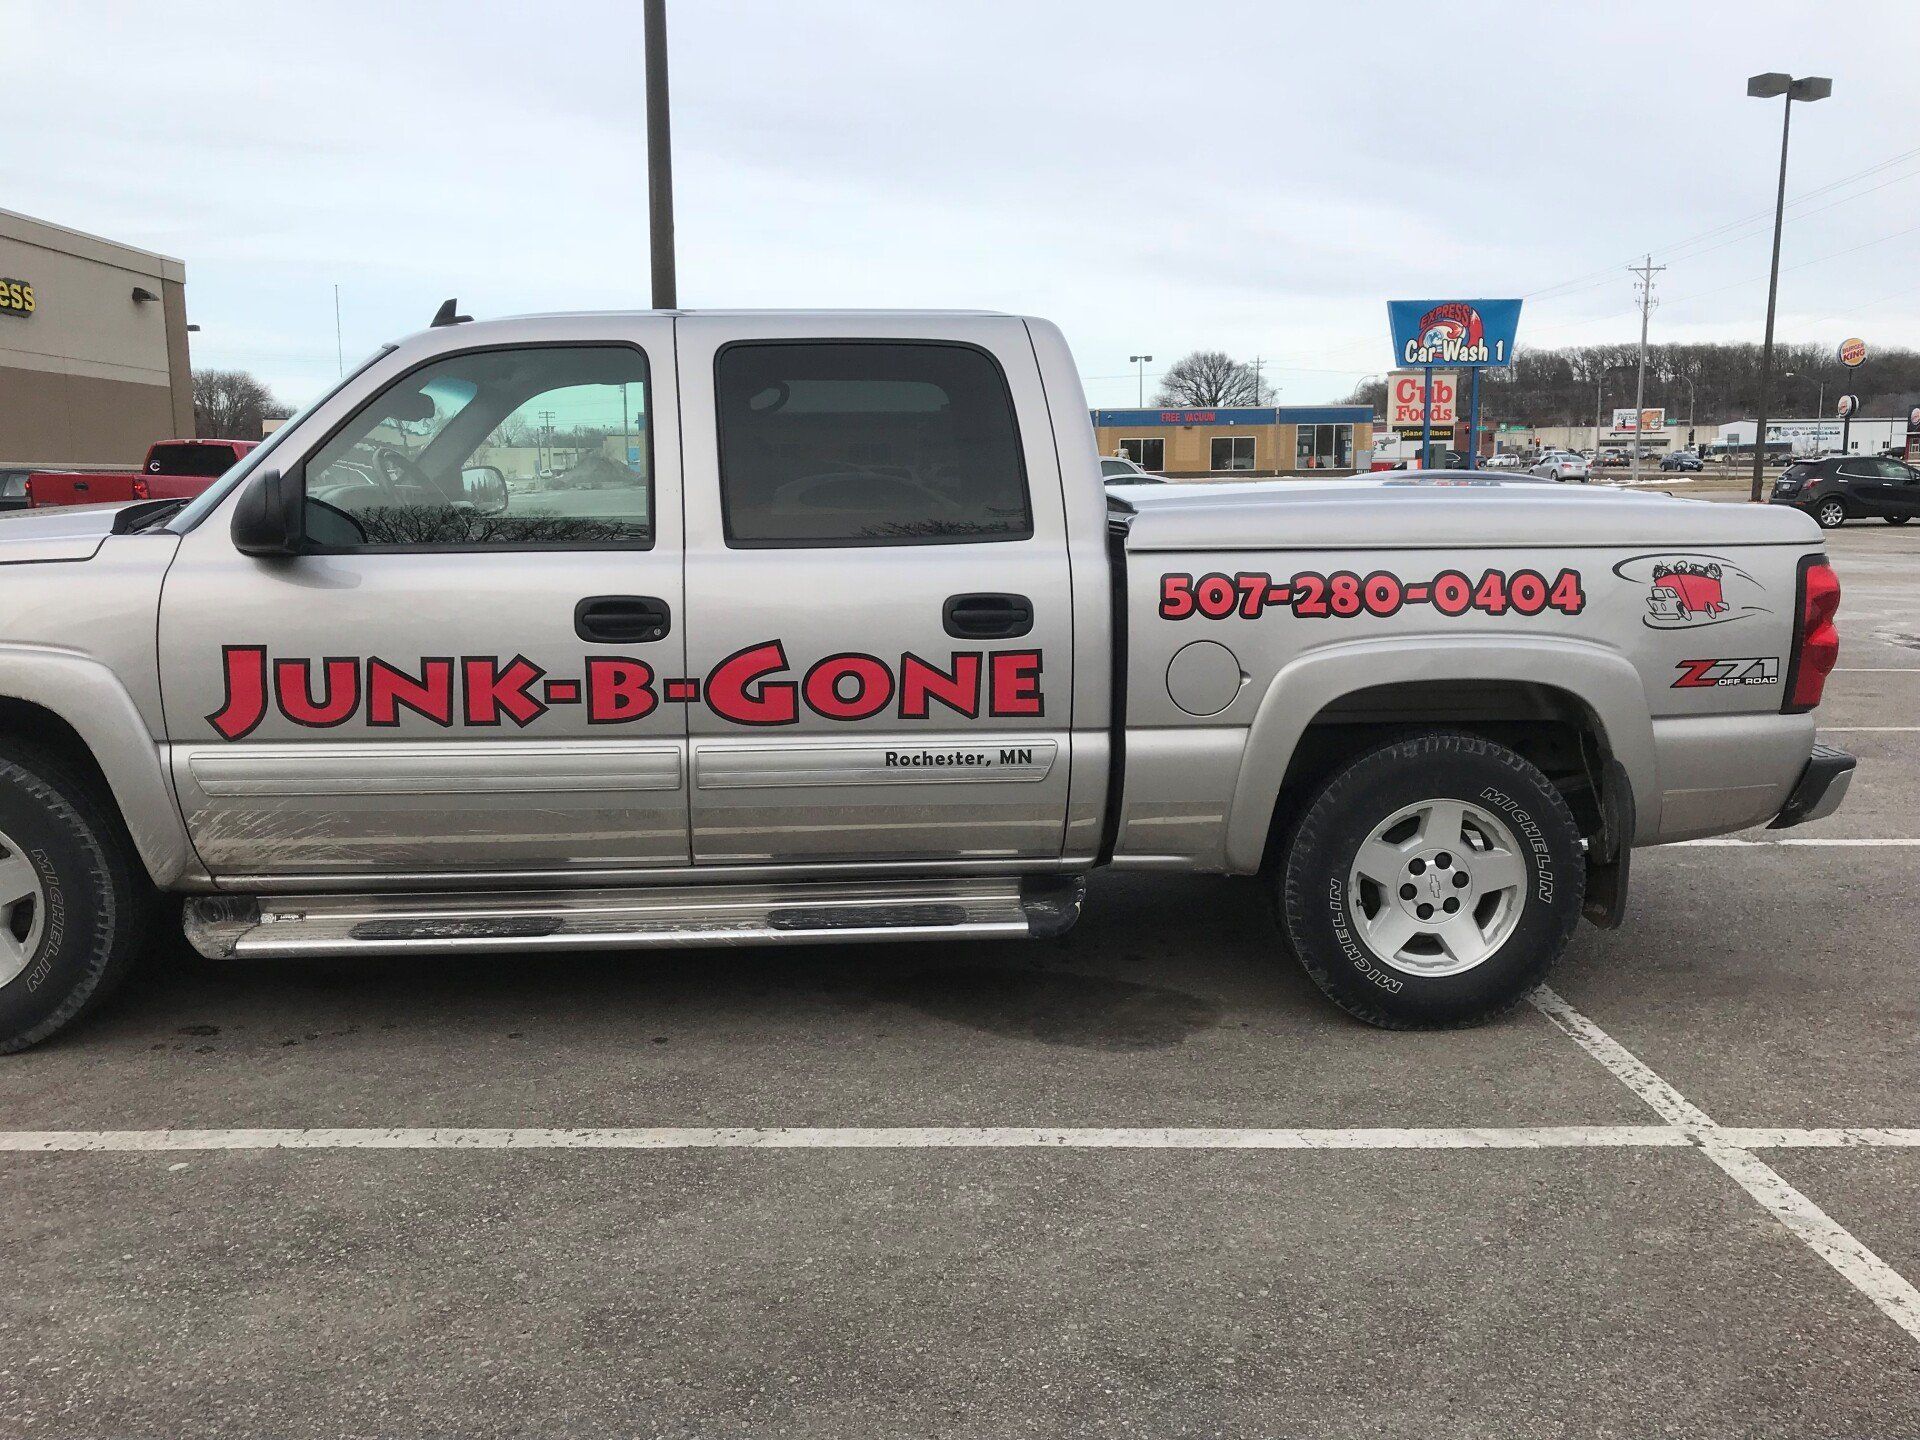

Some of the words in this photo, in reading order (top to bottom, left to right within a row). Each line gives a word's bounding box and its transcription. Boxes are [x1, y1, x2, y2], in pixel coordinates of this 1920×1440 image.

[1419, 303, 1471, 328] EXPRESS
[1404, 338, 1437, 363] Car
[1442, 336, 1489, 362] Wash
[1495, 339, 1505, 362] 1
[1843, 348, 1865, 362] KING
[1161, 412, 1180, 422] FREE
[1184, 411, 1216, 422] VACUUM
[1402, 430, 1426, 438] plane
[1159, 568, 1586, 620] 507-280-0404
[1670, 657, 1779, 688] Z71
[1718, 678, 1741, 686] OFF
[1744, 677, 1778, 685] ROAD
[885, 750, 991, 767] Rochester,
[1000, 749, 1033, 764] MN
[1480, 787, 1553, 903] MICHELIN
[26, 848, 65, 993] MICHELIN
[1329, 878, 1404, 994] MICHELIN
